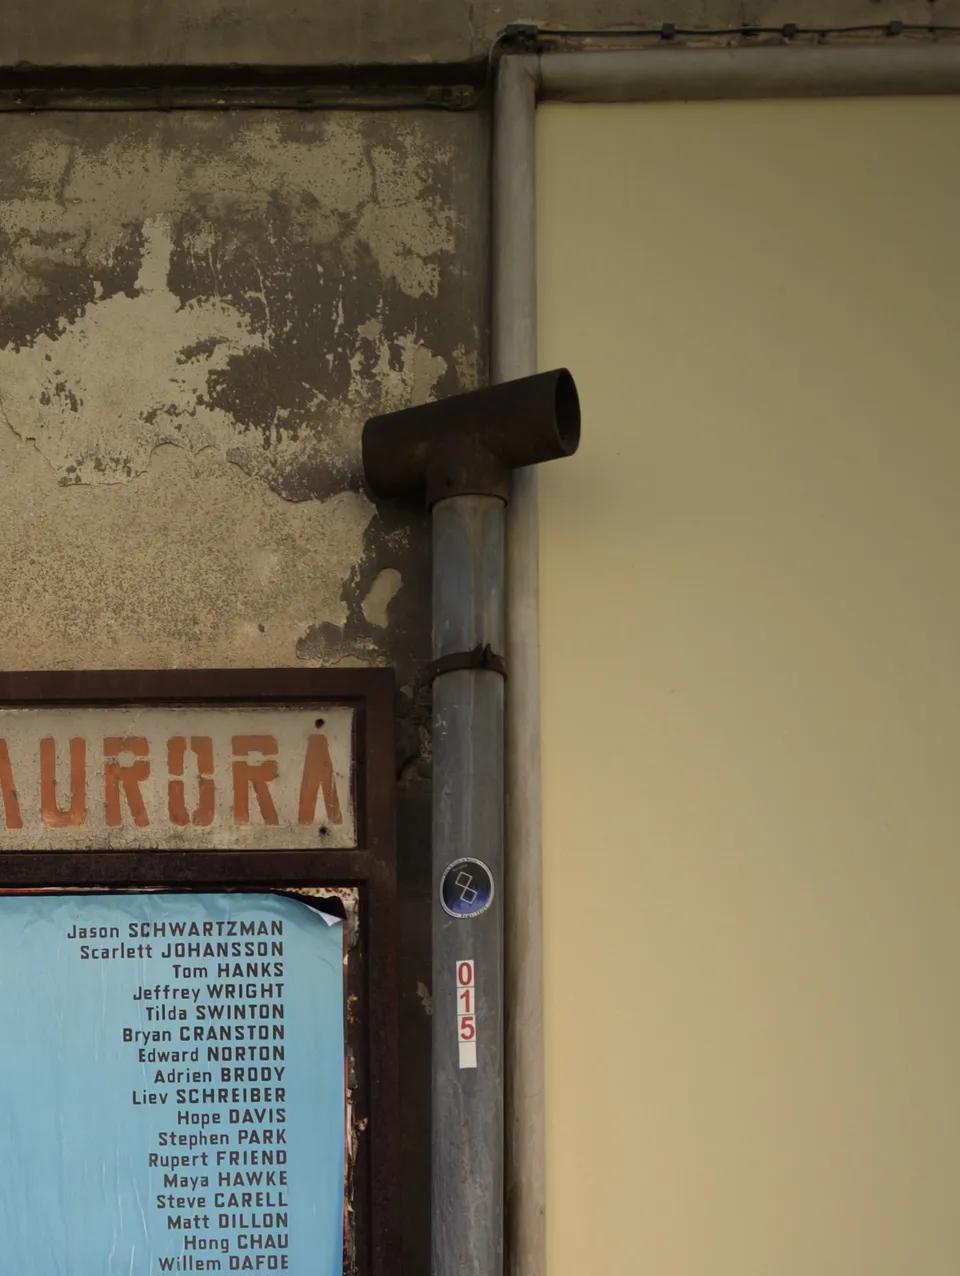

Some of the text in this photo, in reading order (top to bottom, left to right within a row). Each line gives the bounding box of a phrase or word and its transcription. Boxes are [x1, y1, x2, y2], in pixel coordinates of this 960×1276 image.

[67, 920, 284, 939] Jason SCHWARTZMAN
[80, 941, 284, 960] Scarlett JOHANSSON
[172, 962, 284, 979] Tom HANKS
[133, 983, 285, 1003] Jeffrey WRIGHT
[458, 962, 475, 1040] 015
[146, 1004, 285, 1021] Tilda SWINTON
[123, 1024, 285, 1046] Bryan CRANSTON
[138, 1045, 285, 1063] Edward NORTON
[154, 1066, 285, 1084] Adrien BRODY
[132, 1087, 286, 1105] Liev SCHREIBER
[177, 1108, 286, 1129] Hope DAVIS
[158, 1128, 287, 1150] Stephen PARK
[149, 1150, 287, 1171] Rupert FRIEND
[164, 1170, 288, 1191] Maya HAWKE
[156, 1191, 288, 1209] Steve CARELL
[167, 1212, 288, 1230] Matt DILLON
[184, 1233, 289, 1253] Hong CHAU
[159, 1255, 289, 1271] Willem DAFOE
